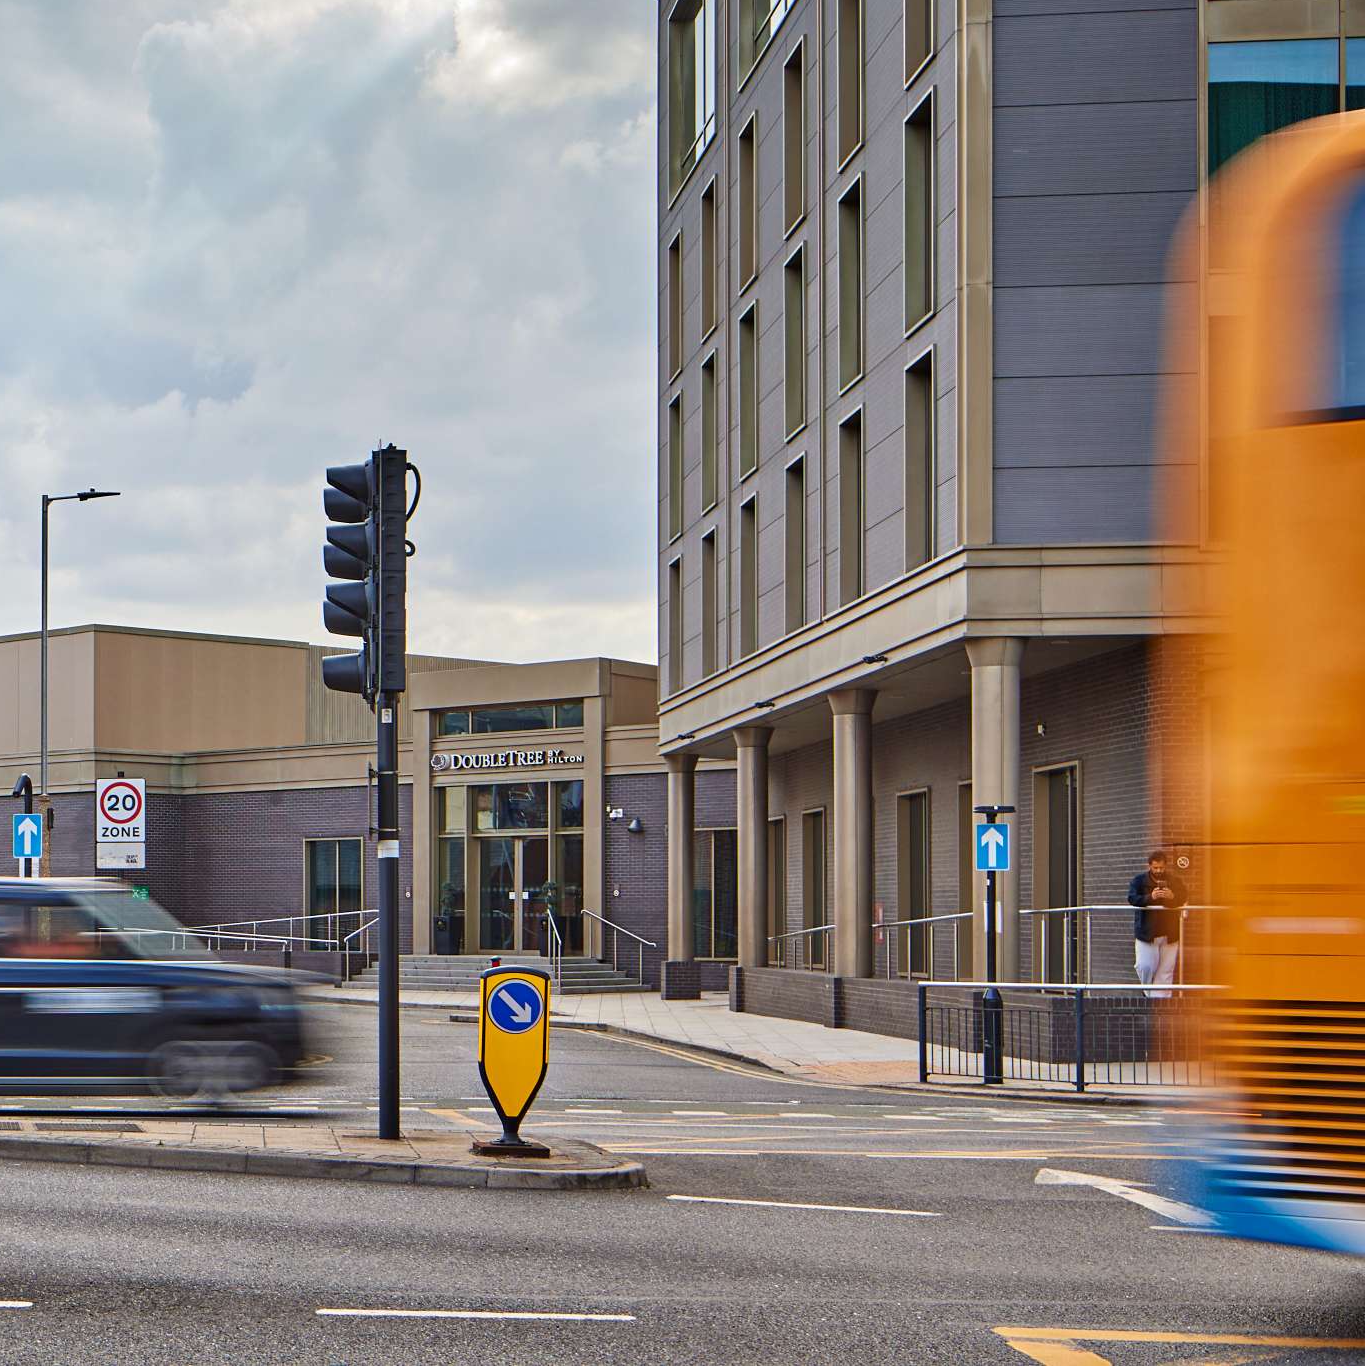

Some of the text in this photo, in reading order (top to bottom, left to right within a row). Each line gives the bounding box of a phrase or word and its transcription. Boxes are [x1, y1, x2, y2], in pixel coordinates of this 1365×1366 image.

[548, 756, 583, 764] HILTON
[107, 794, 136, 811] 20
[101, 827, 140, 837] ZONE
